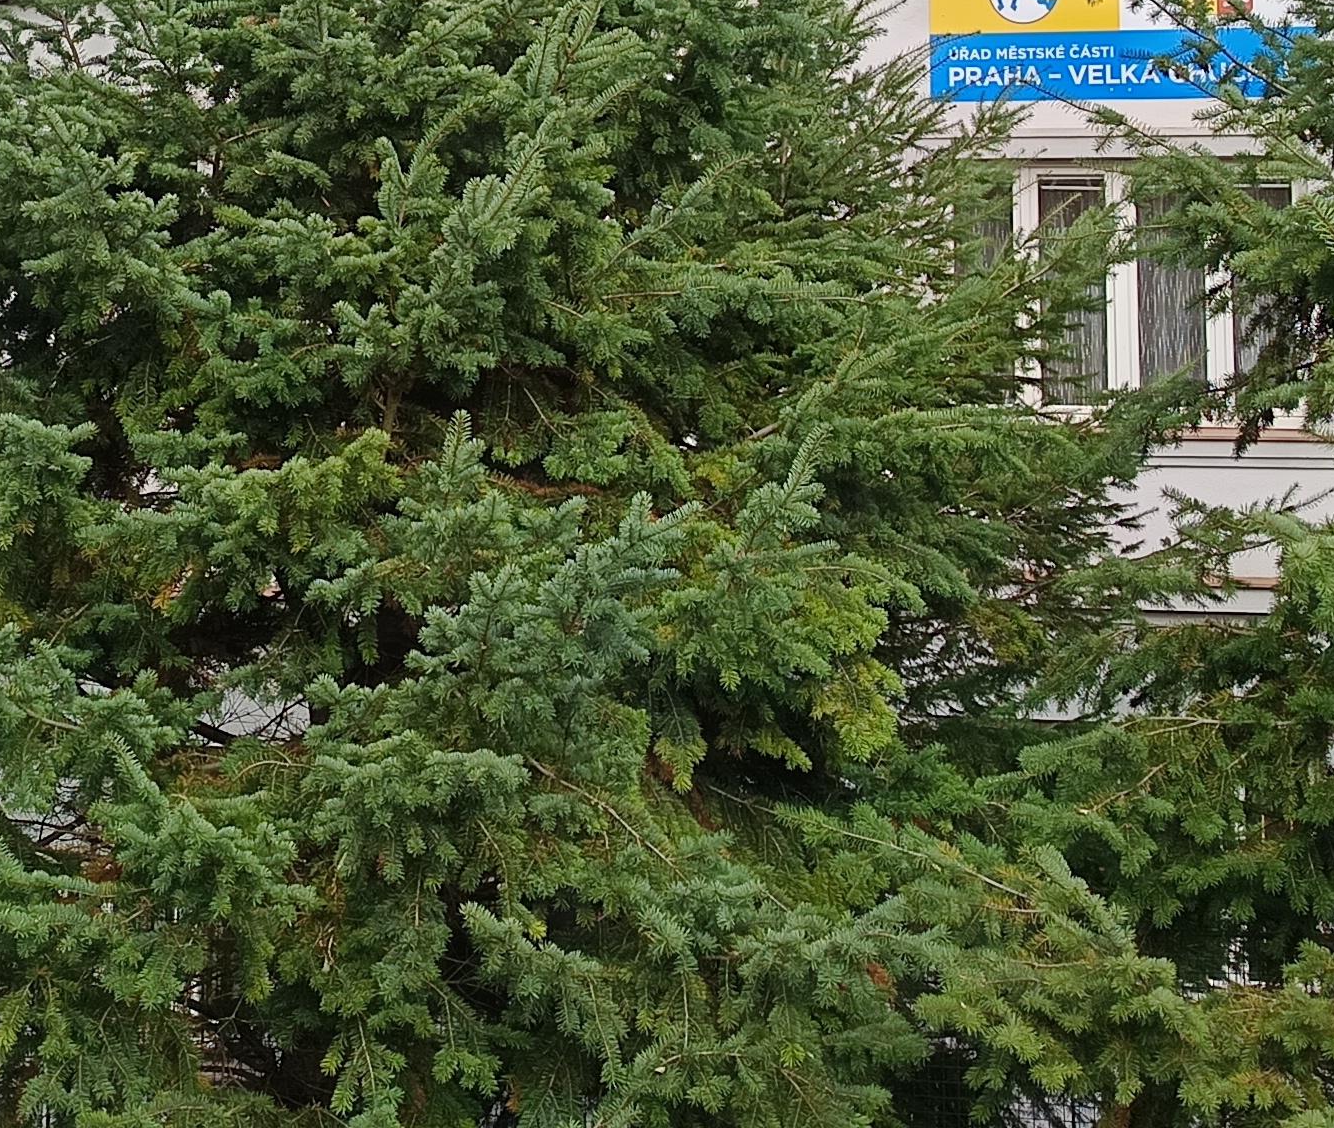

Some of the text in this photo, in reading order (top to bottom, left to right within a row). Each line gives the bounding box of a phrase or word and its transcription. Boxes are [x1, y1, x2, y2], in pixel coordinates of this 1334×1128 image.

[949, 44, 1115, 61] ÚŘAD MĚSTSKÉ ČÁSTI
[949, 65, 1041, 87] PRAHA
[1068, 59, 1160, 85] VELKÁ
